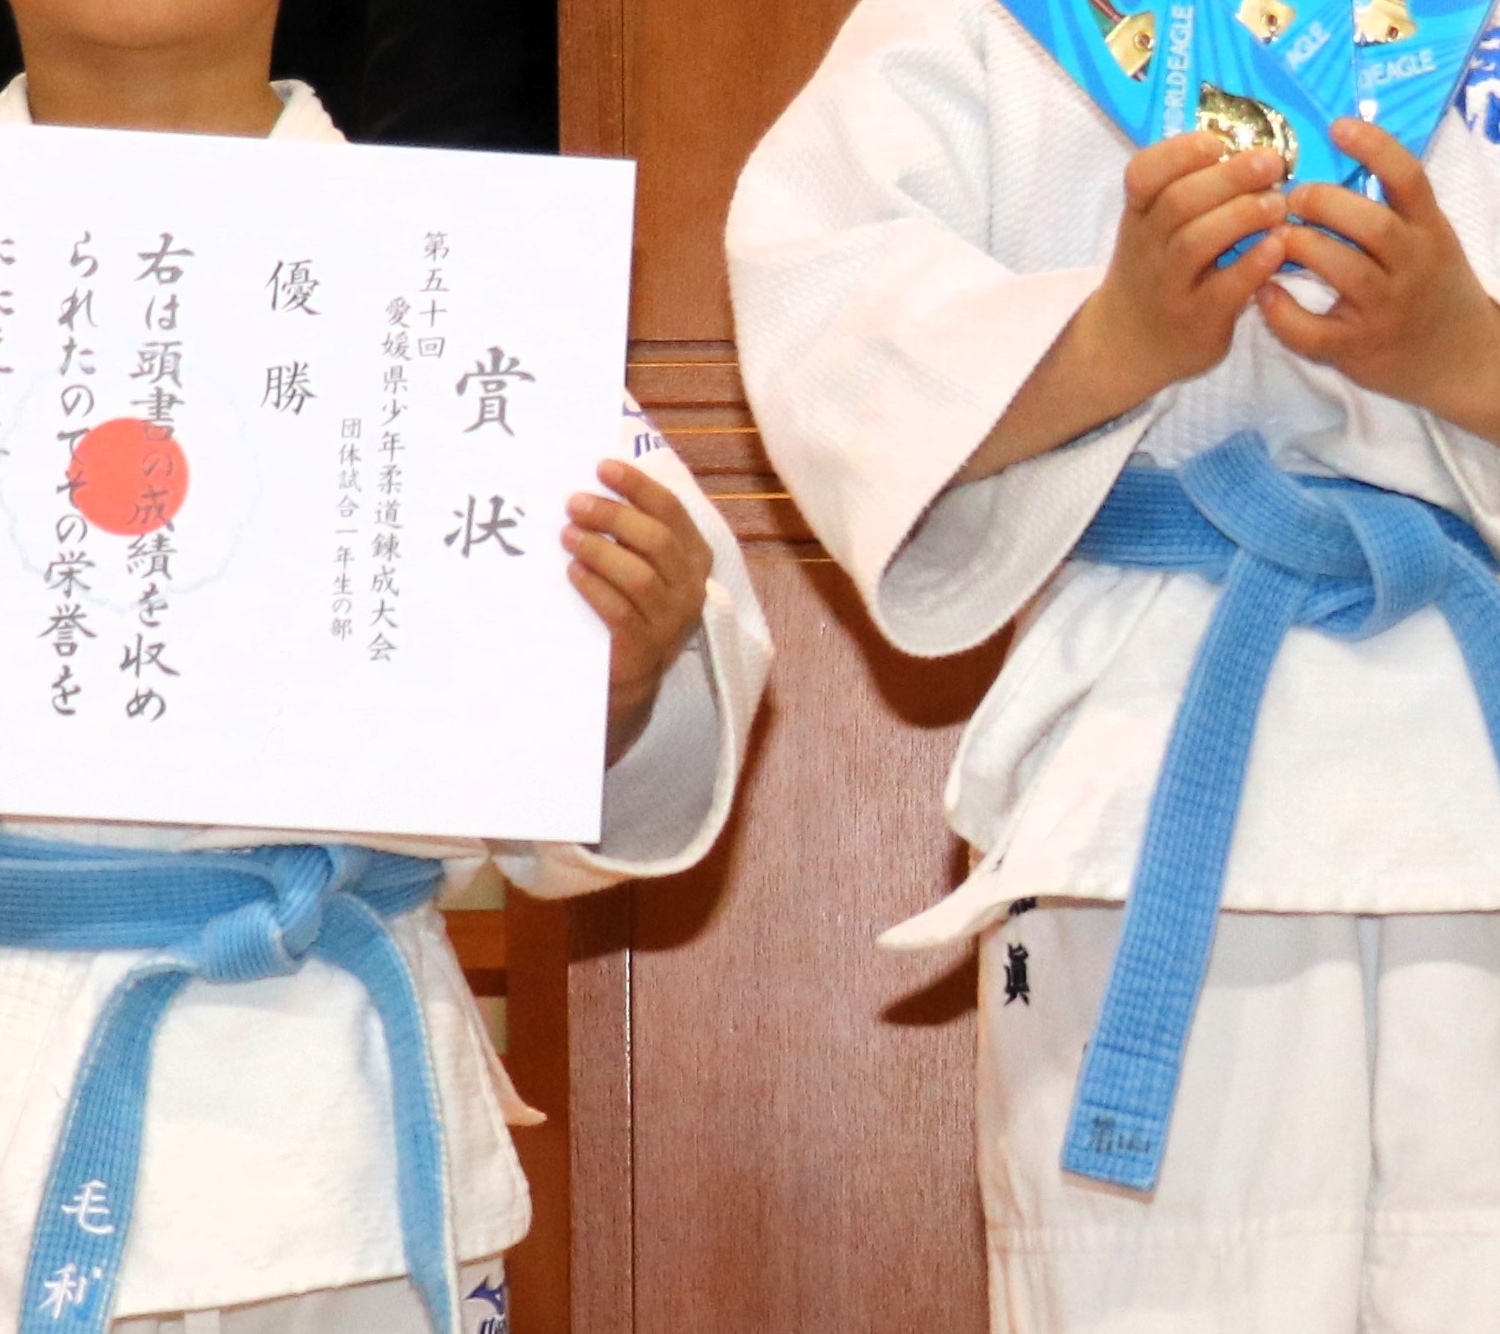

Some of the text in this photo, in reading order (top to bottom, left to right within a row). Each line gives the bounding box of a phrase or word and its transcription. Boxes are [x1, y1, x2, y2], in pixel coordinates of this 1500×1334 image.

[259, 258, 322, 417] 優勝
[417, 230, 451, 360] 第五十回
[120, 231, 196, 723] 右は頭書の成績を収め
[330, 417, 364, 643] 団体試合一年生の部
[443, 346, 537, 559] 賞状
[39, 1178, 117, 1321] 毛利
